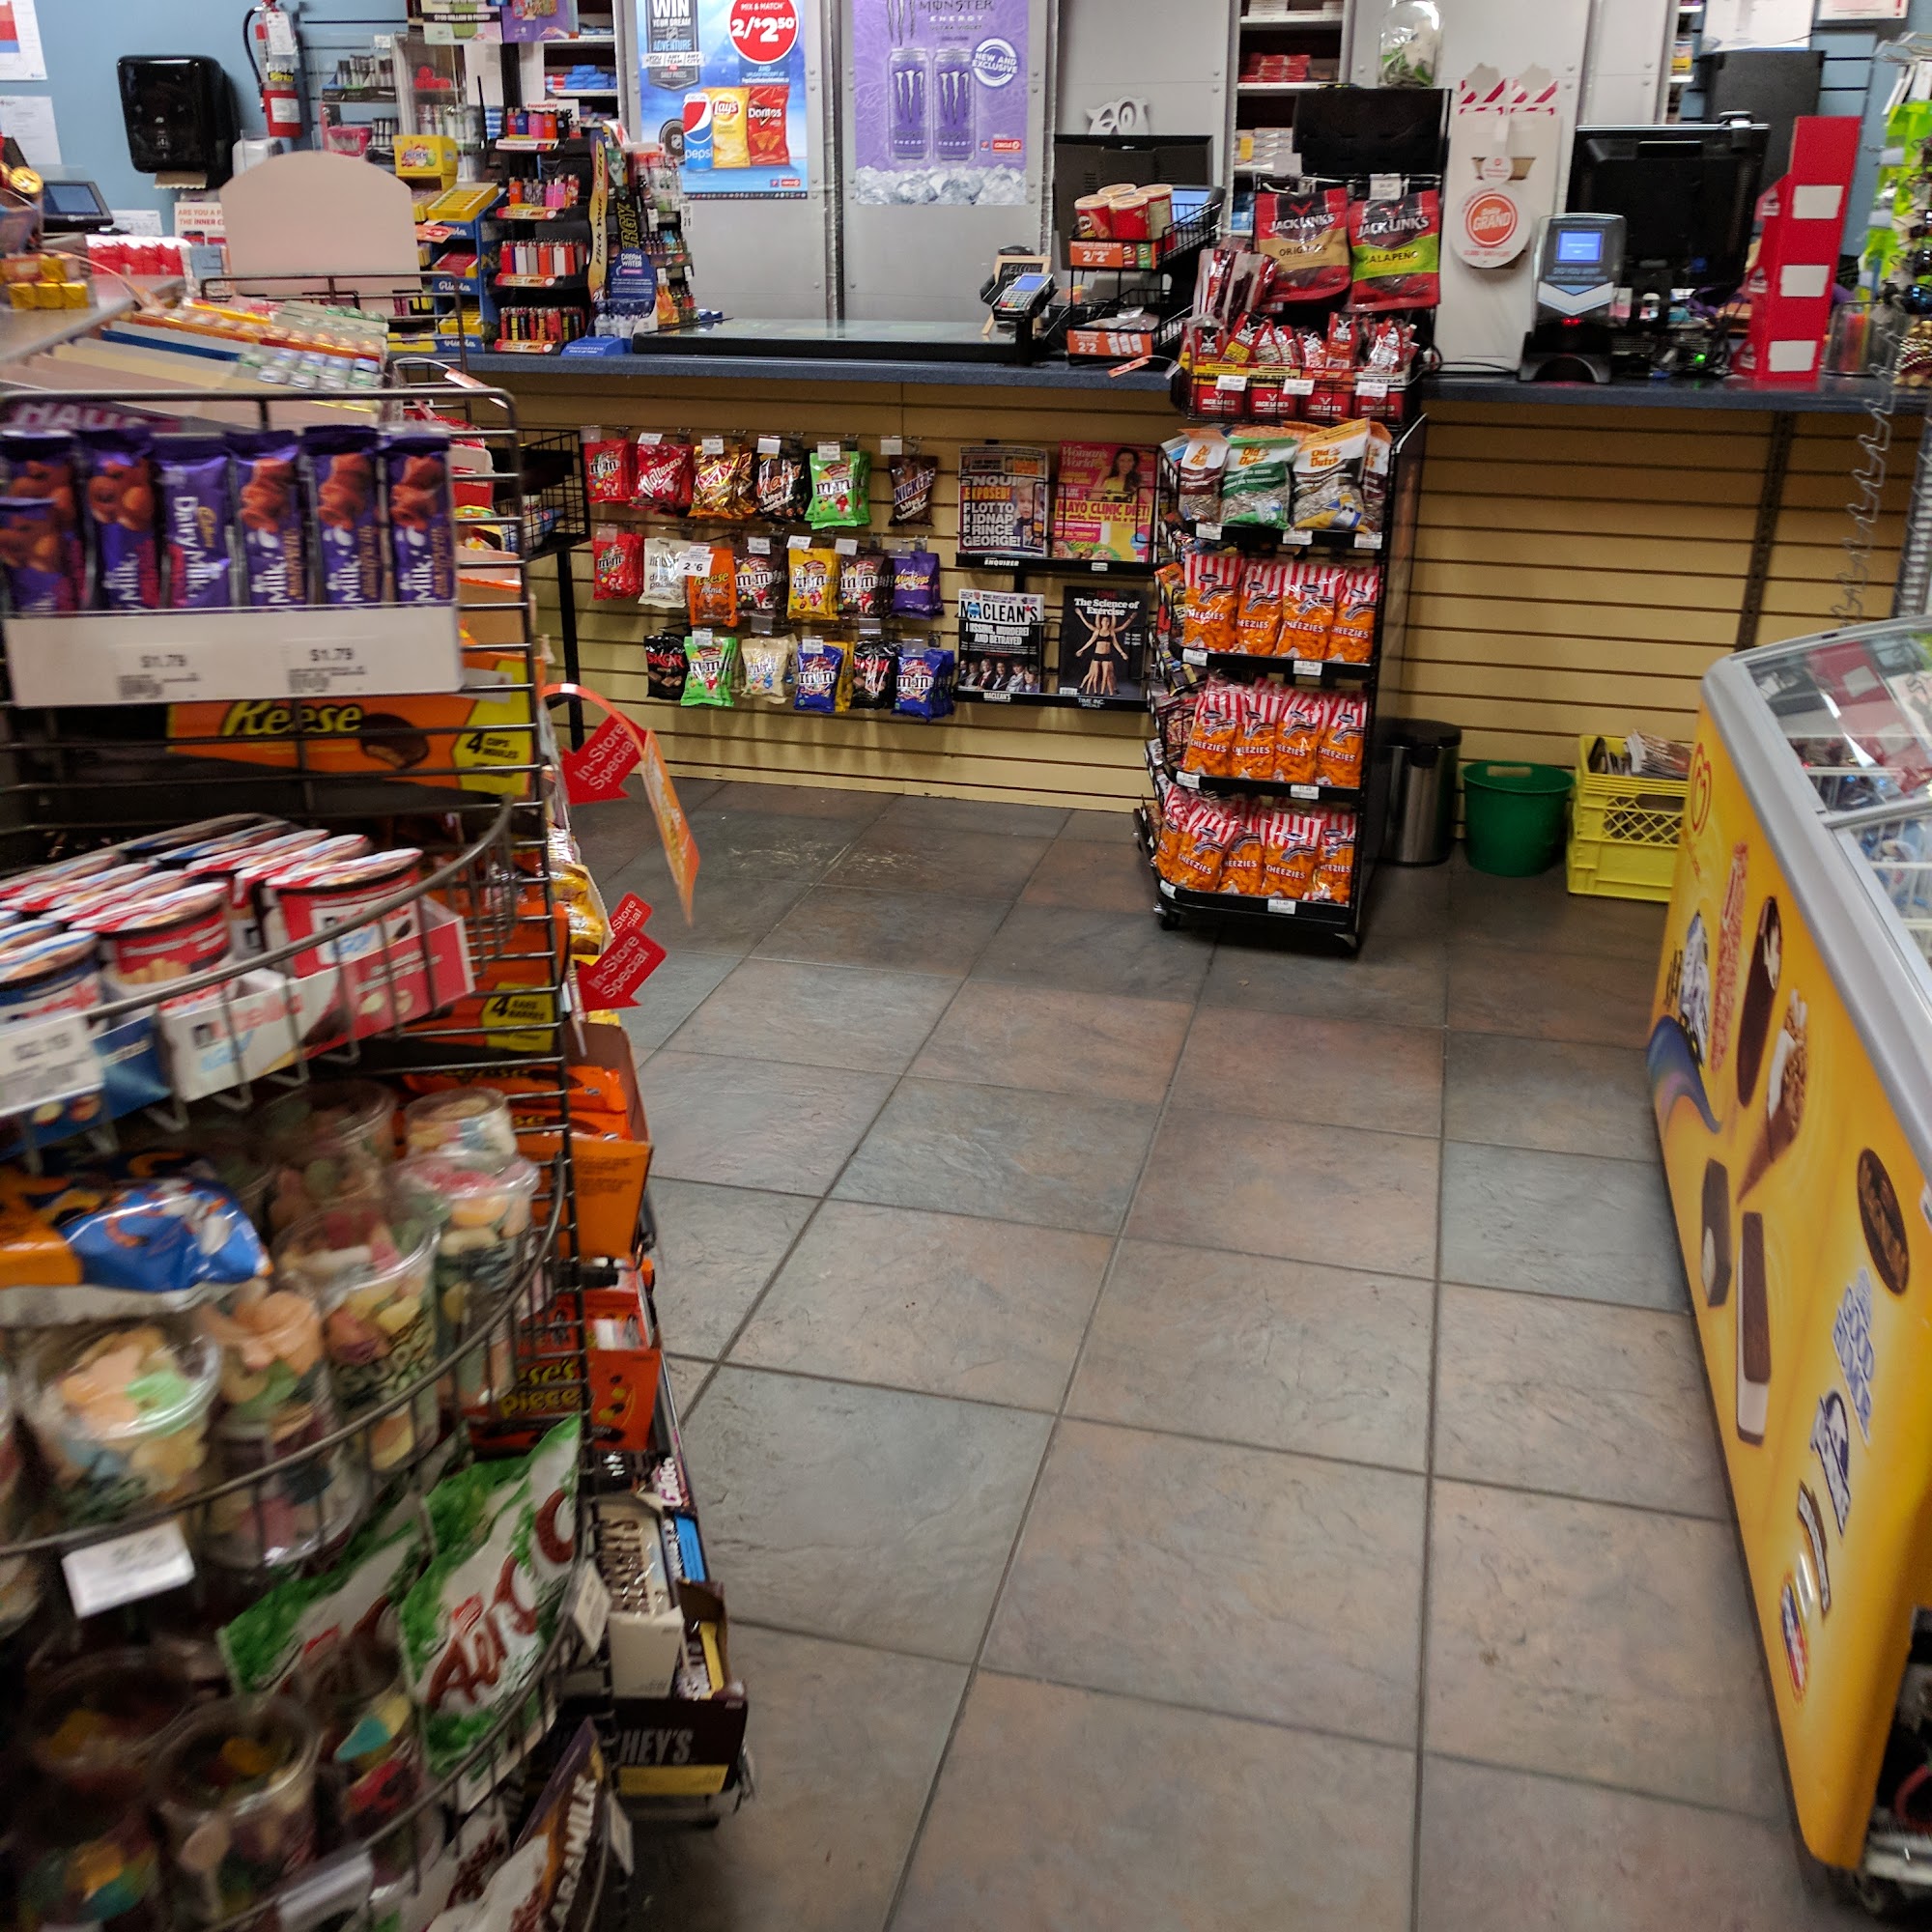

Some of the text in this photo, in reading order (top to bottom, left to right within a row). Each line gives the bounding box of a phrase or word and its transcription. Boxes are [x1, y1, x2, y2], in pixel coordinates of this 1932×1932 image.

[653, 0, 690, 17] WIN
[920, 0, 995, 12] MONSTER
[669, 17, 692, 26] DREAM
[653, 40, 693, 51] ADVENTURE
[972, 61, 1018, 73] EXCLUSIVE
[976, 53, 1017, 66] NEW AND
[748, 107, 781, 118] Doritos
[685, 147, 712, 161] pepsi
[1269, 217, 1298, 233] JACK
[1473, 212, 1512, 231] GRAND
[1357, 222, 1387, 239] JACK
[439, 281, 470, 292] Ricla
[1242, 447, 1259, 457] Old
[1311, 449, 1330, 458] Old
[1310, 456, 1339, 469] Dutch
[639, 458, 682, 497] Maltesers
[997, 502, 1015, 514] TO
[1091, 502, 1122, 515] CLINIC
[174, 497, 200, 548] Dairy
[962, 536, 1021, 547] GEORGE!
[112, 558, 143, 601] Milk
[183, 550, 212, 599] Milk
[264, 560, 292, 603] Milk
[337, 559, 363, 602] Milk
[411, 559, 436, 602] Milk
[1073, 598, 1140, 610] The Science of
[1086, 607, 1125, 616] Exercise
[974, 634, 988, 643] AND
[466, 733, 482, 754] 4
[574, 723, 626, 781] In-Store
[1190, 738, 1227, 753] CHEEZIES
[588, 735, 636, 790] Special
[1179, 853, 1212, 875] CHEEZIES
[1266, 865, 1305, 880] CHEEZIES
[612, 899, 636, 933] -Store
[627, 907, 643, 928] cial
[587, 935, 639, 989] In-Store
[601, 947, 650, 999] Special
[492, 994, 510, 1016] 4
[499, 1389, 580, 1418] piece
[617, 1727, 696, 1766] HEY'S
